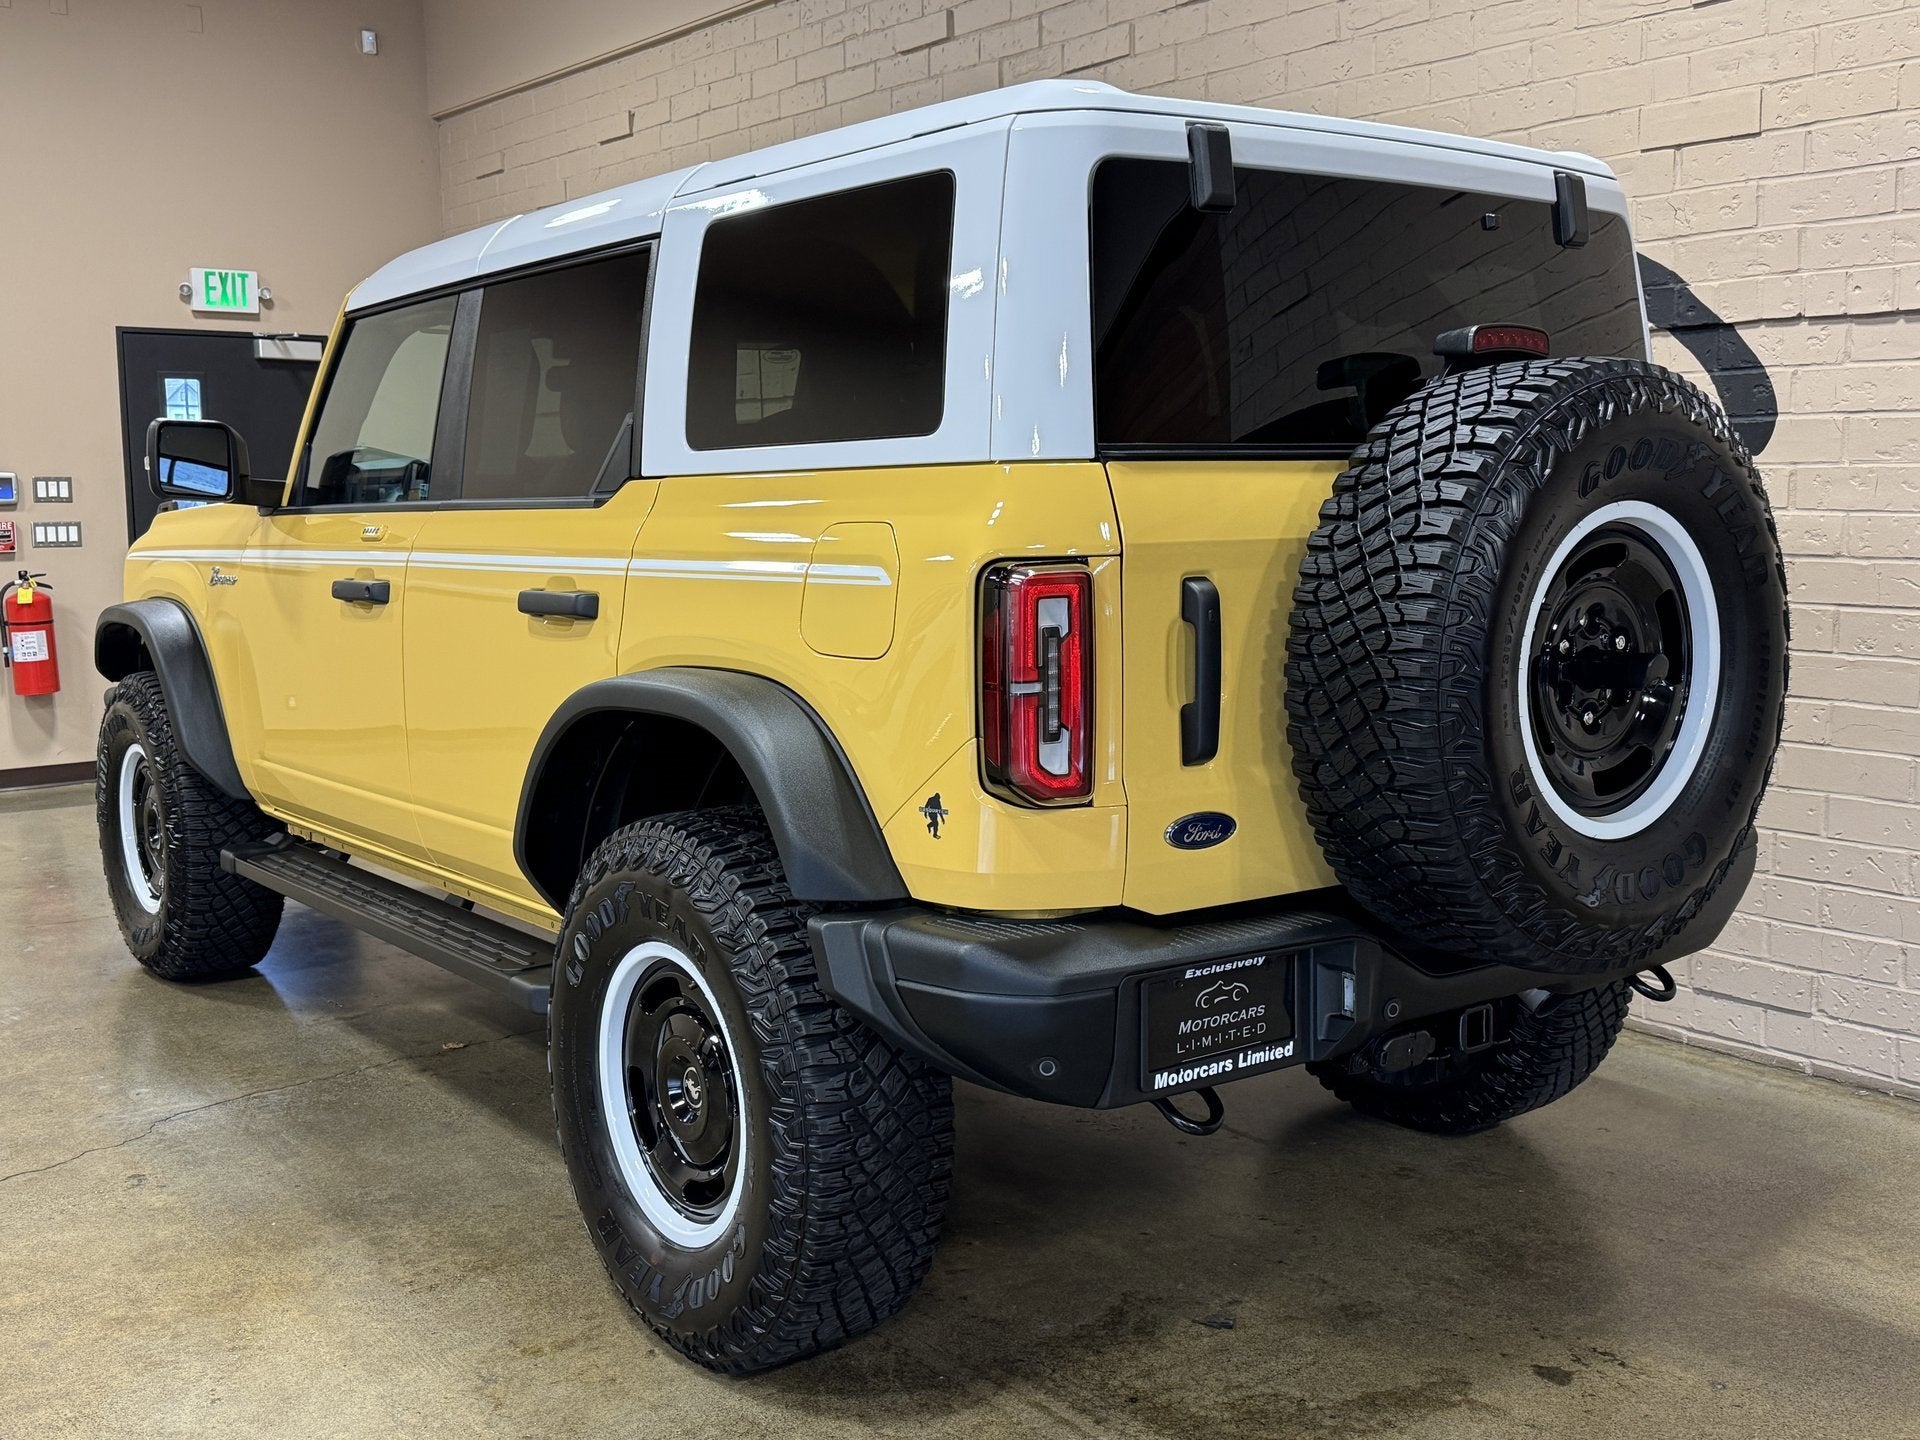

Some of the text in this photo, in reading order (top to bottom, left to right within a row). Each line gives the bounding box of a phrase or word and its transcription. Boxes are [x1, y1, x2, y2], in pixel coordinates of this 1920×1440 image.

[204, 271, 249, 307] EXIT
[1578, 437, 1680, 499] GOOD
[1184, 822, 1222, 843] Ford
[565, 897, 616, 988] GOOD
[1184, 955, 1266, 979] Exclusively
[1178, 1004, 1266, 1035] MOTORCARS
[1154, 1041, 1294, 1090] Motorcars Limited
